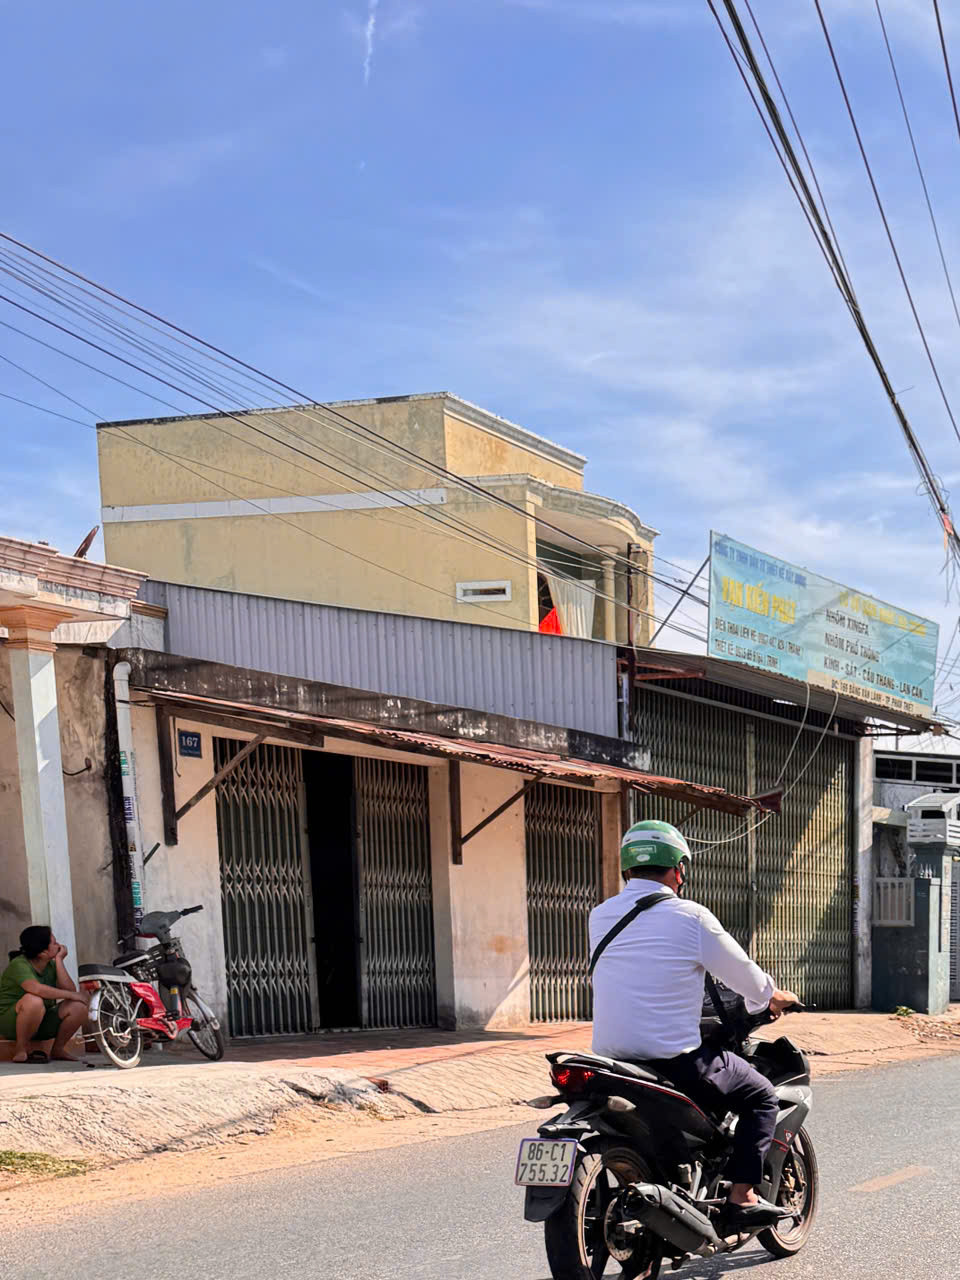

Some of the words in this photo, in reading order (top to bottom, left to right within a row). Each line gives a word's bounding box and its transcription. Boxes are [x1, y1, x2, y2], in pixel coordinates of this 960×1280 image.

[182, 736, 199, 748] 167
[527, 1142, 567, 1162] 86-C1
[518, 1163, 569, 1183] 755.32
